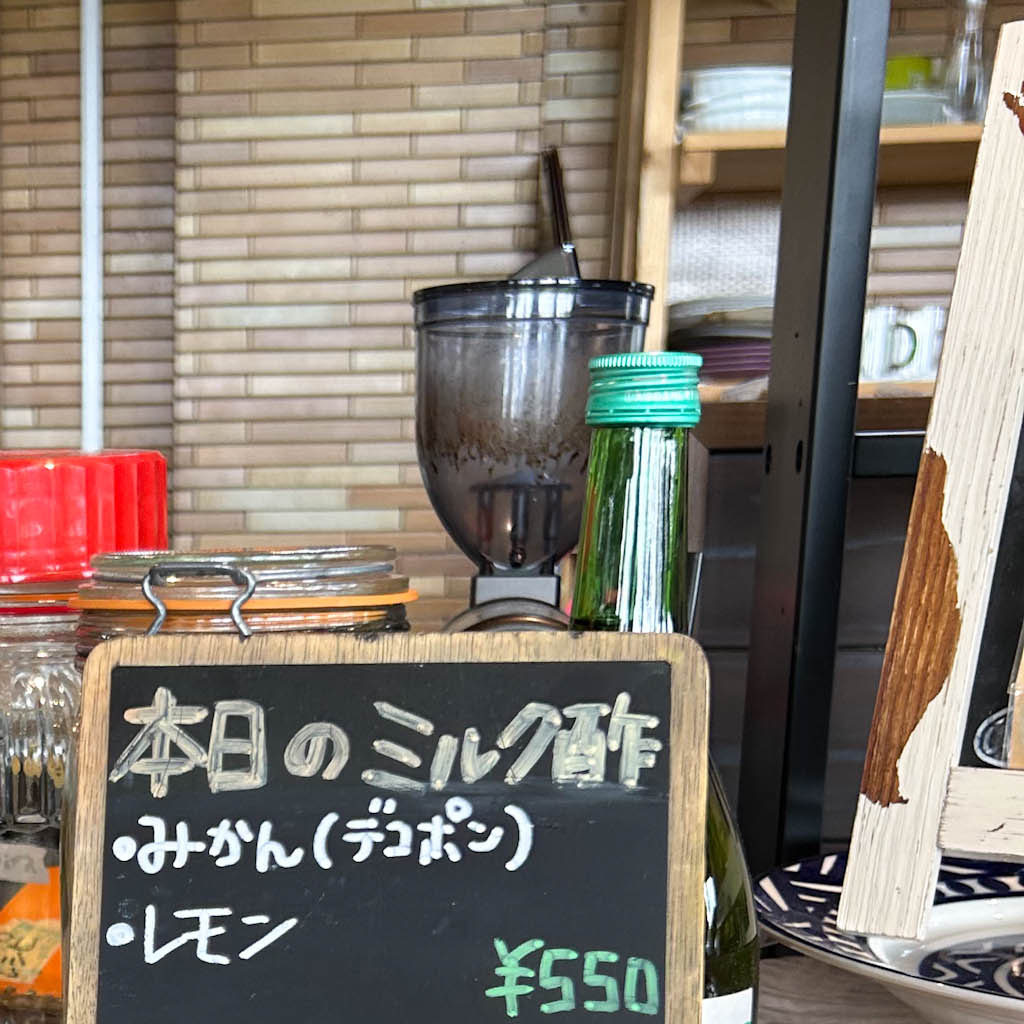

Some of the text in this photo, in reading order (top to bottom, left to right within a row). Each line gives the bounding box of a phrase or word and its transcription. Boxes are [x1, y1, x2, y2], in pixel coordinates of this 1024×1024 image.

[109, 686, 662, 798] 本日のミルク酢
[485, 937, 660, 1018] ¥550
